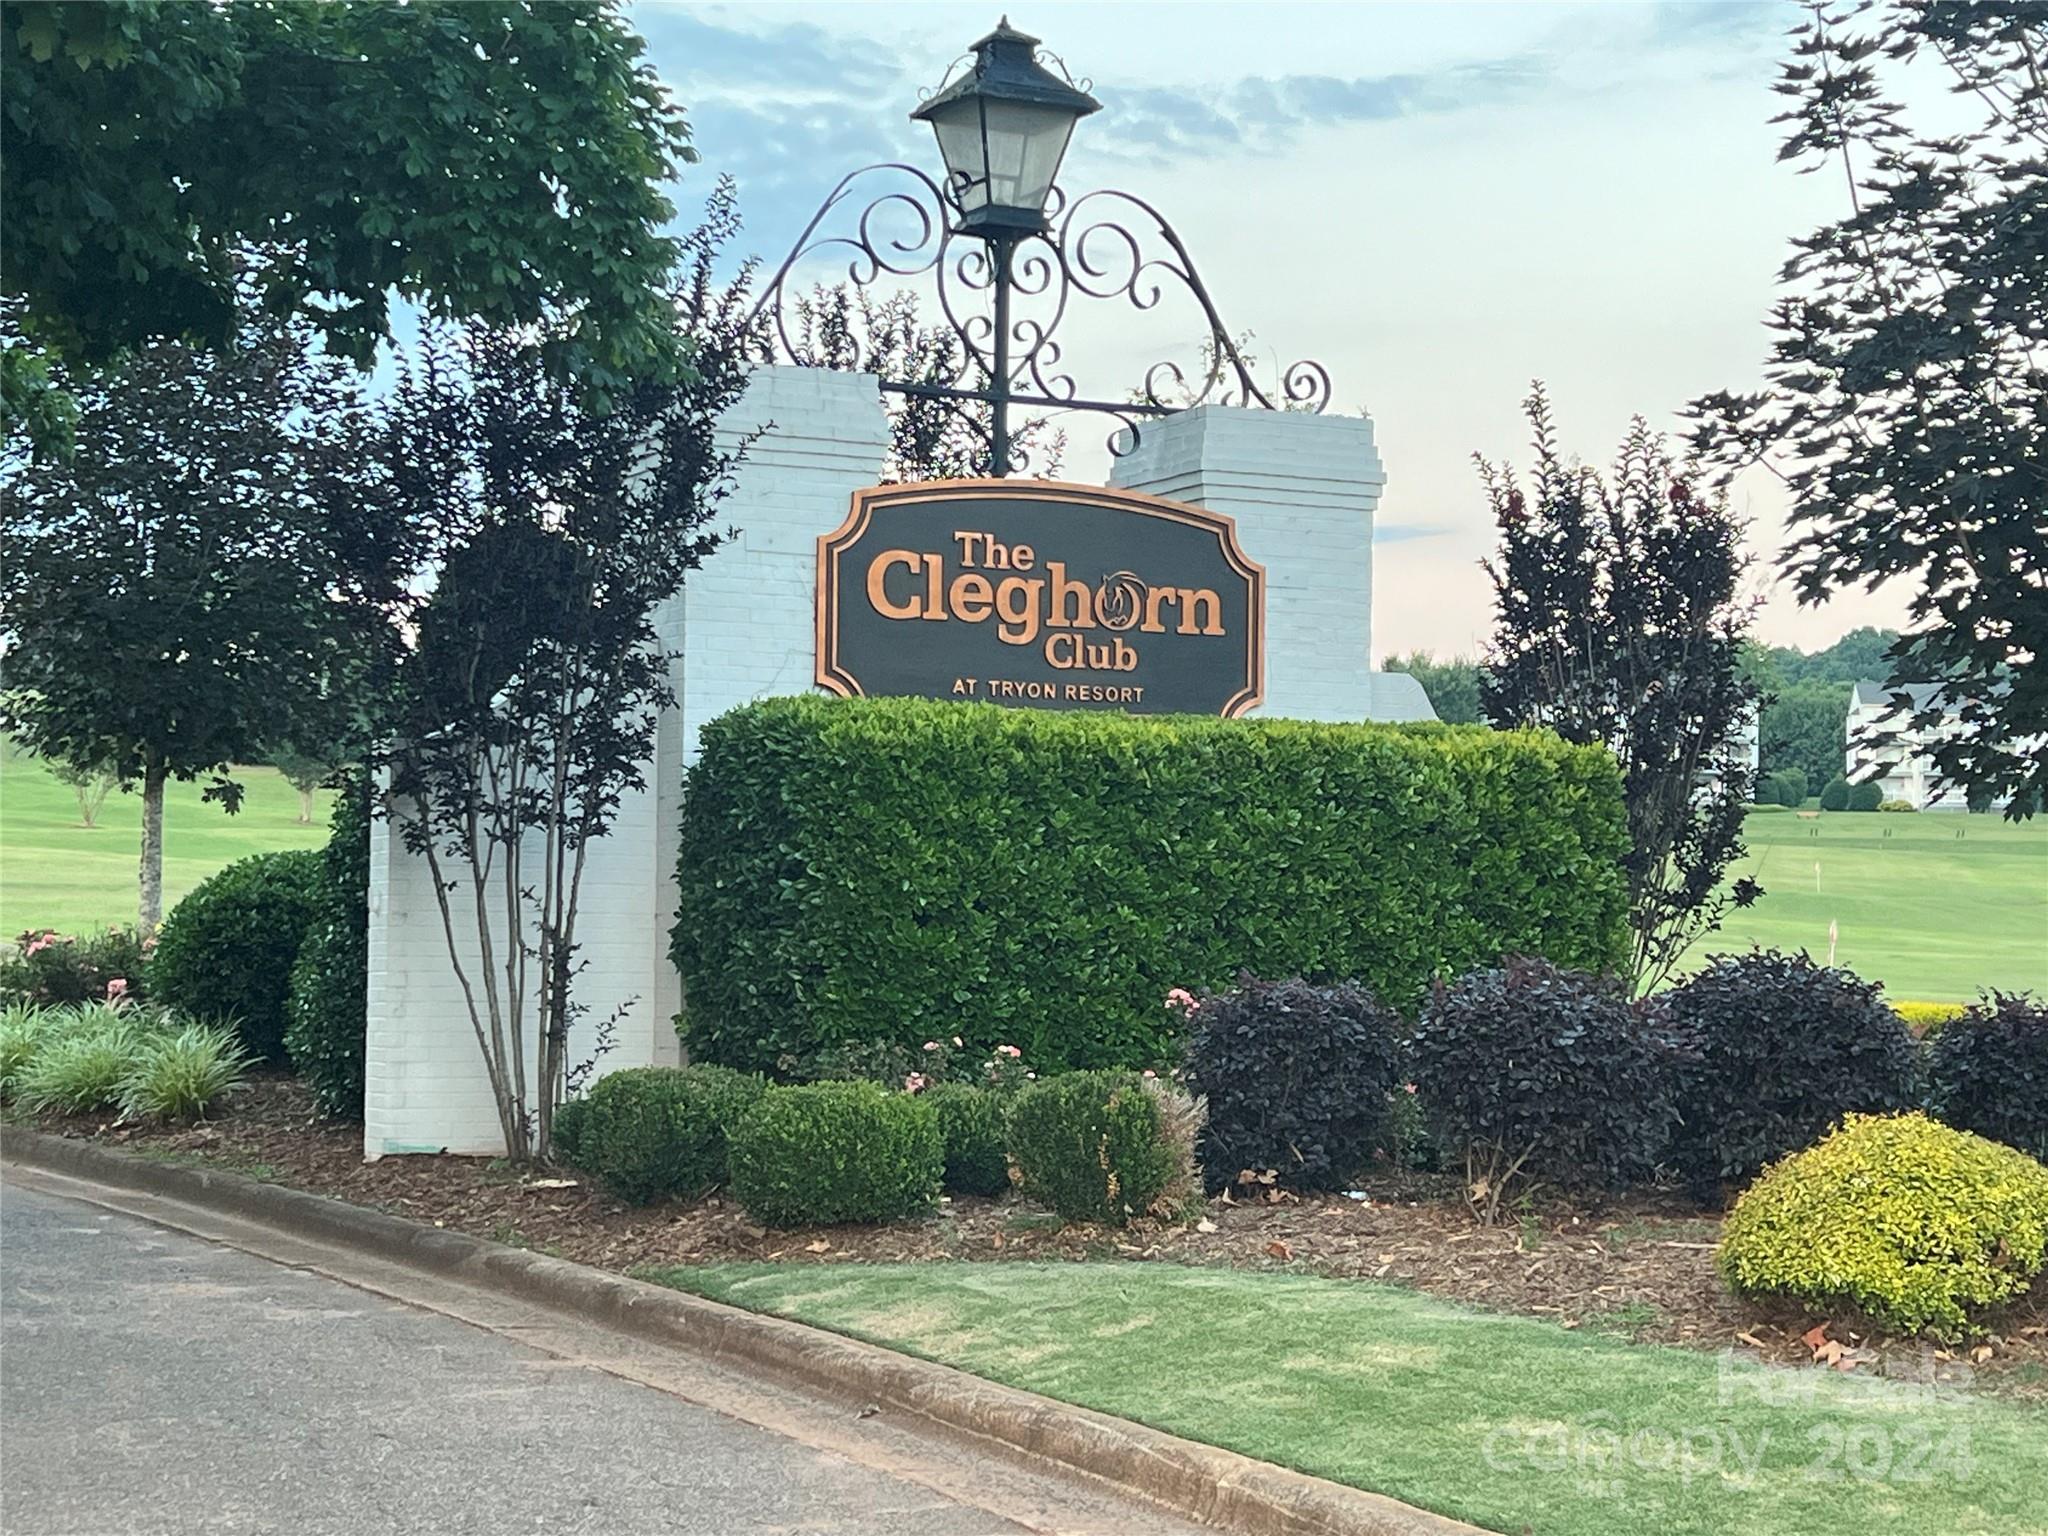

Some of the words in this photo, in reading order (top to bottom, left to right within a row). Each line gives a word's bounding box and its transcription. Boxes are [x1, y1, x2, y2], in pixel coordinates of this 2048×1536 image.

[953, 530, 1035, 571] The
[866, 549, 1226, 645] Cleghorn
[1044, 632, 1139, 672] Club
[952, 678, 978, 695] AT
[988, 680, 1056, 699] TRYON
[1064, 684, 1145, 703] RESORT
